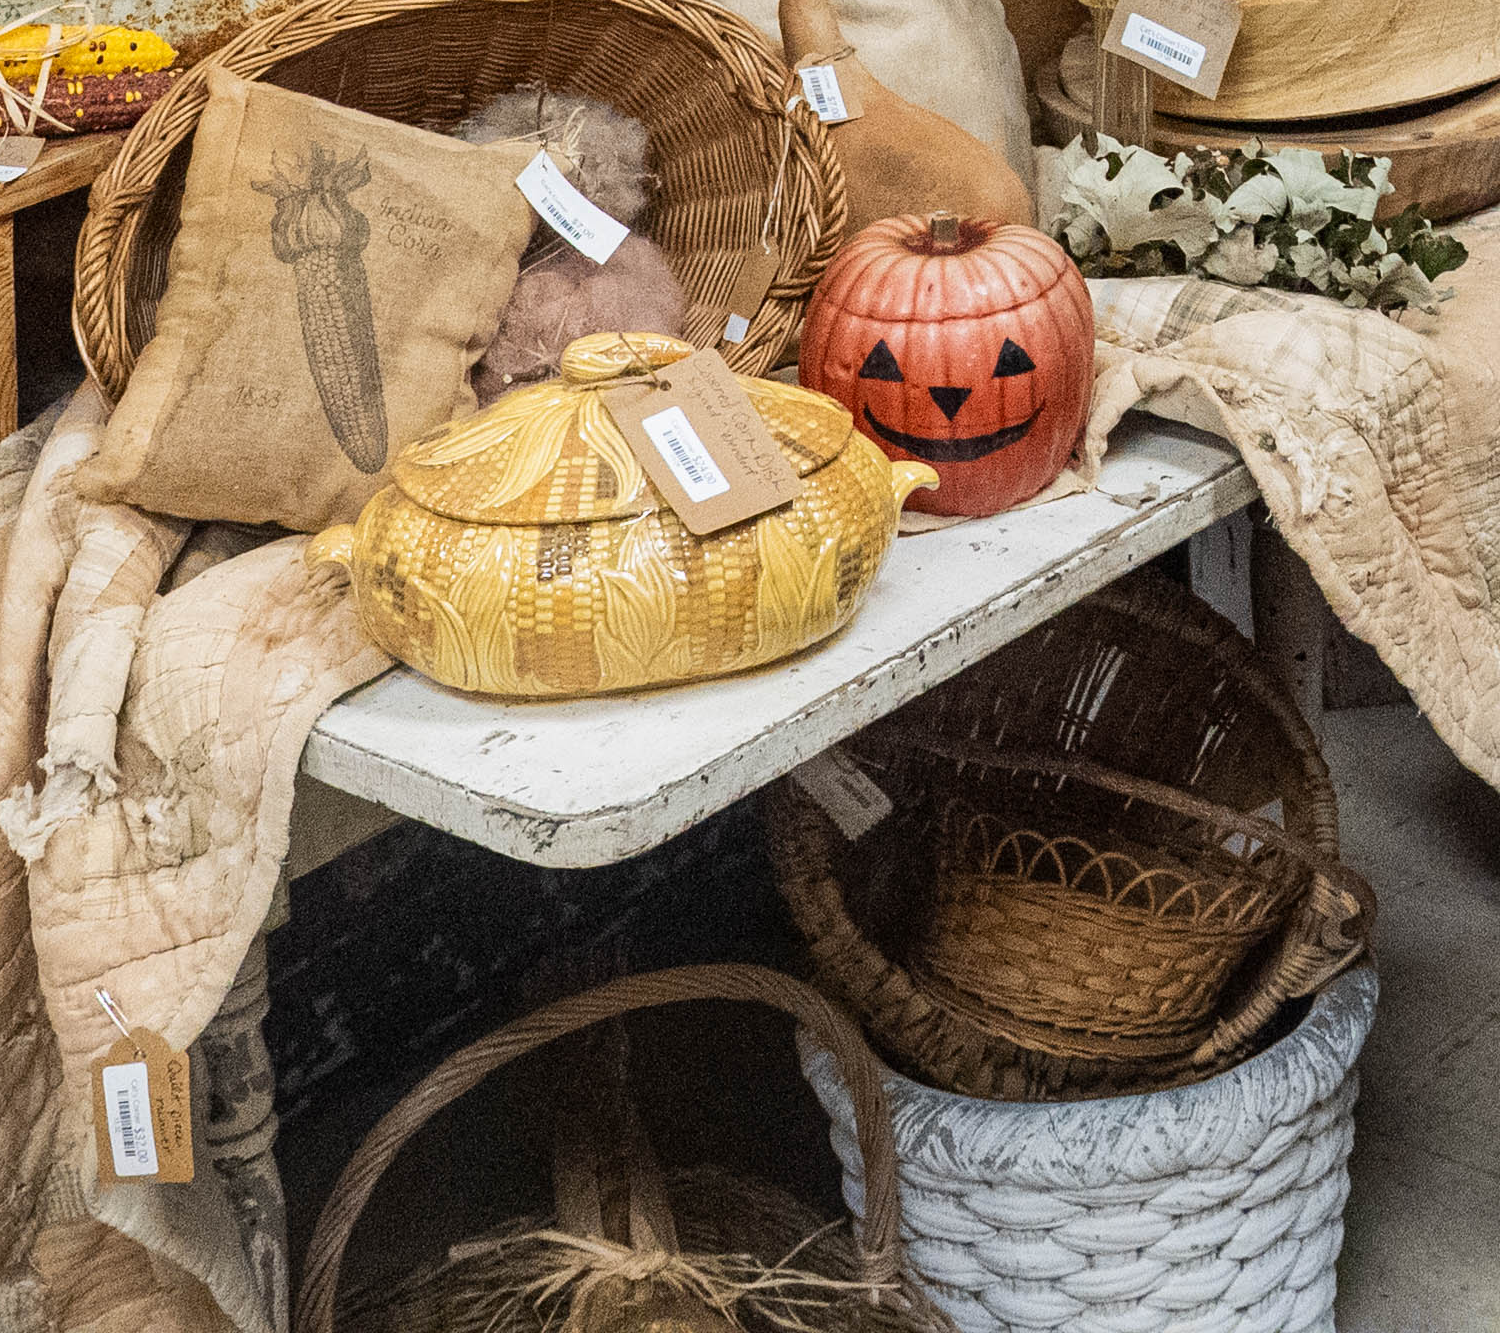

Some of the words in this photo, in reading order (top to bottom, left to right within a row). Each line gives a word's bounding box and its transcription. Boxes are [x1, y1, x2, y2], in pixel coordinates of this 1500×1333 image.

[378, 195, 456, 233] Indian
[571, 217, 596, 241] $7.00
[387, 222, 443, 261] Corn
[167, 1058, 185, 1107] Quilt
[134, 1126, 151, 1164] $32.00
